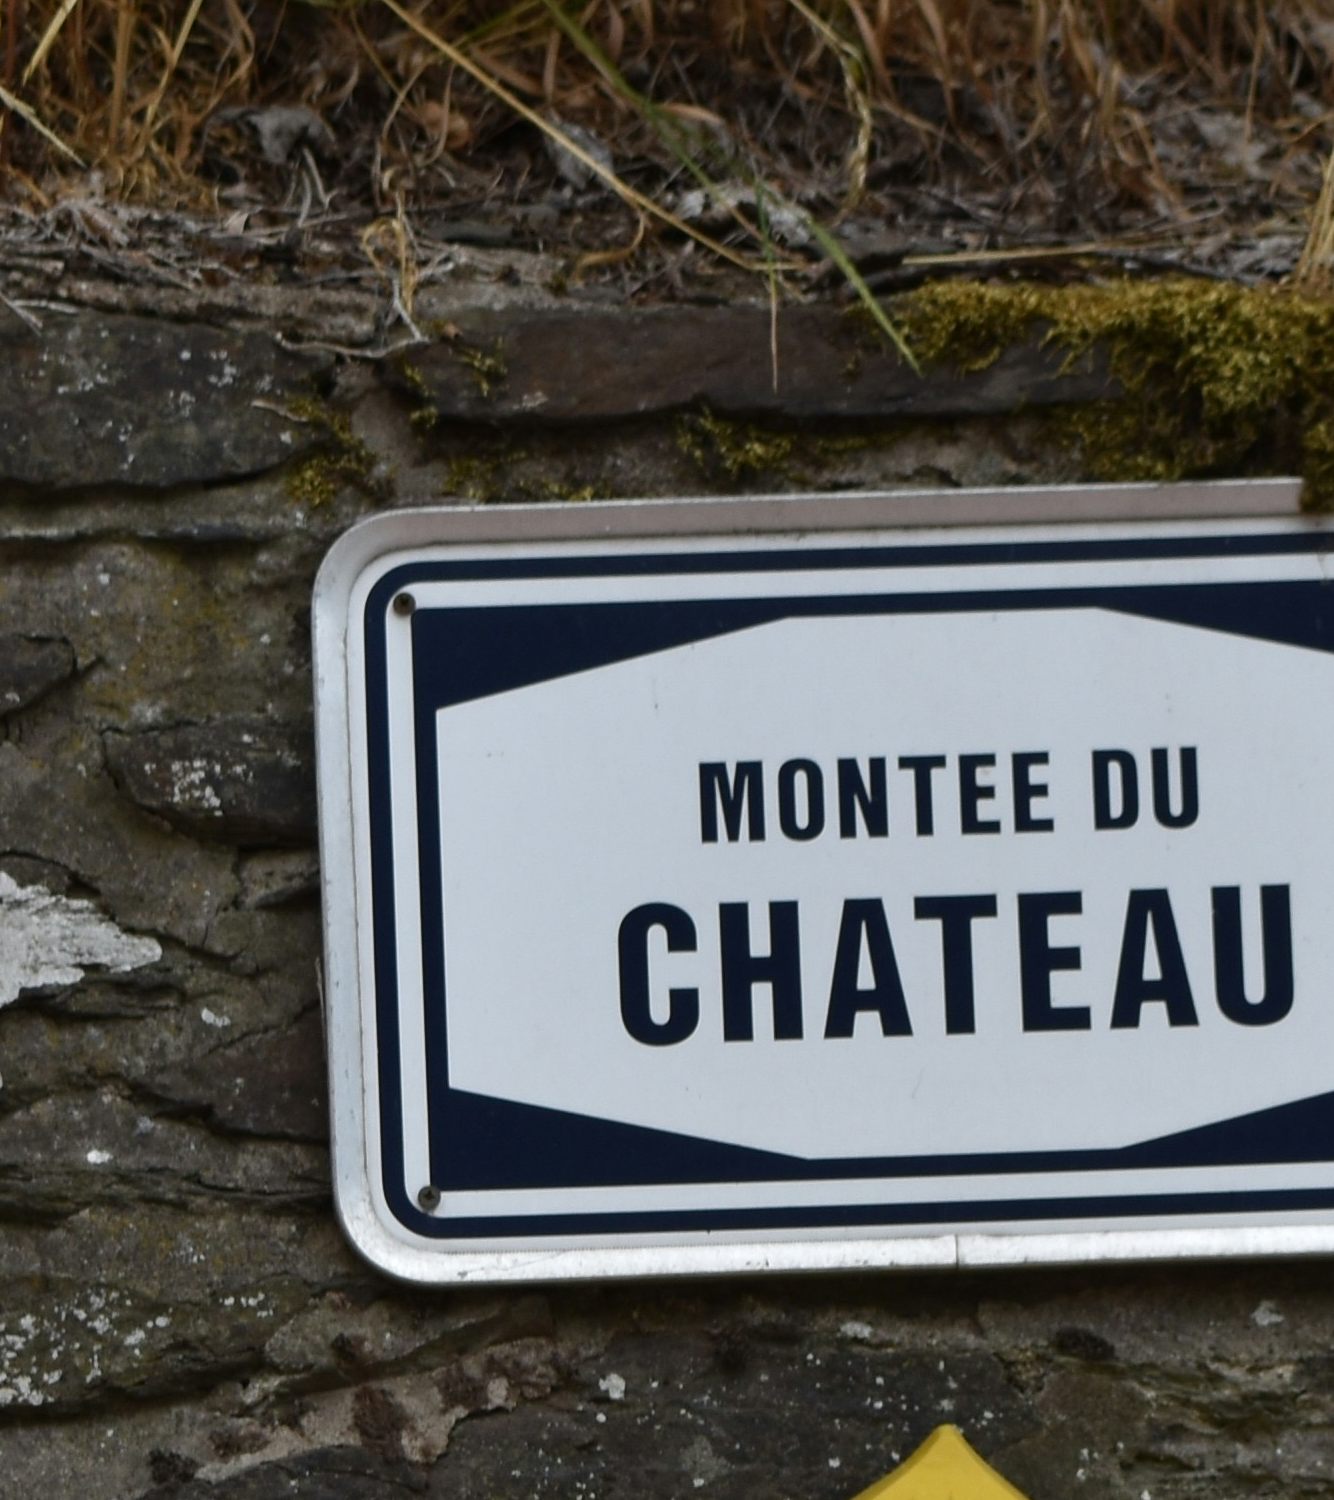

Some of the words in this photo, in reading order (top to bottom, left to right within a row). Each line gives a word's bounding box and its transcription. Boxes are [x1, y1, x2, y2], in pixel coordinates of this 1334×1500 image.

[699, 752, 1054, 843] MONTEE
[1091, 746, 1199, 832] DU
[616, 883, 1296, 1047] CHATEAU
